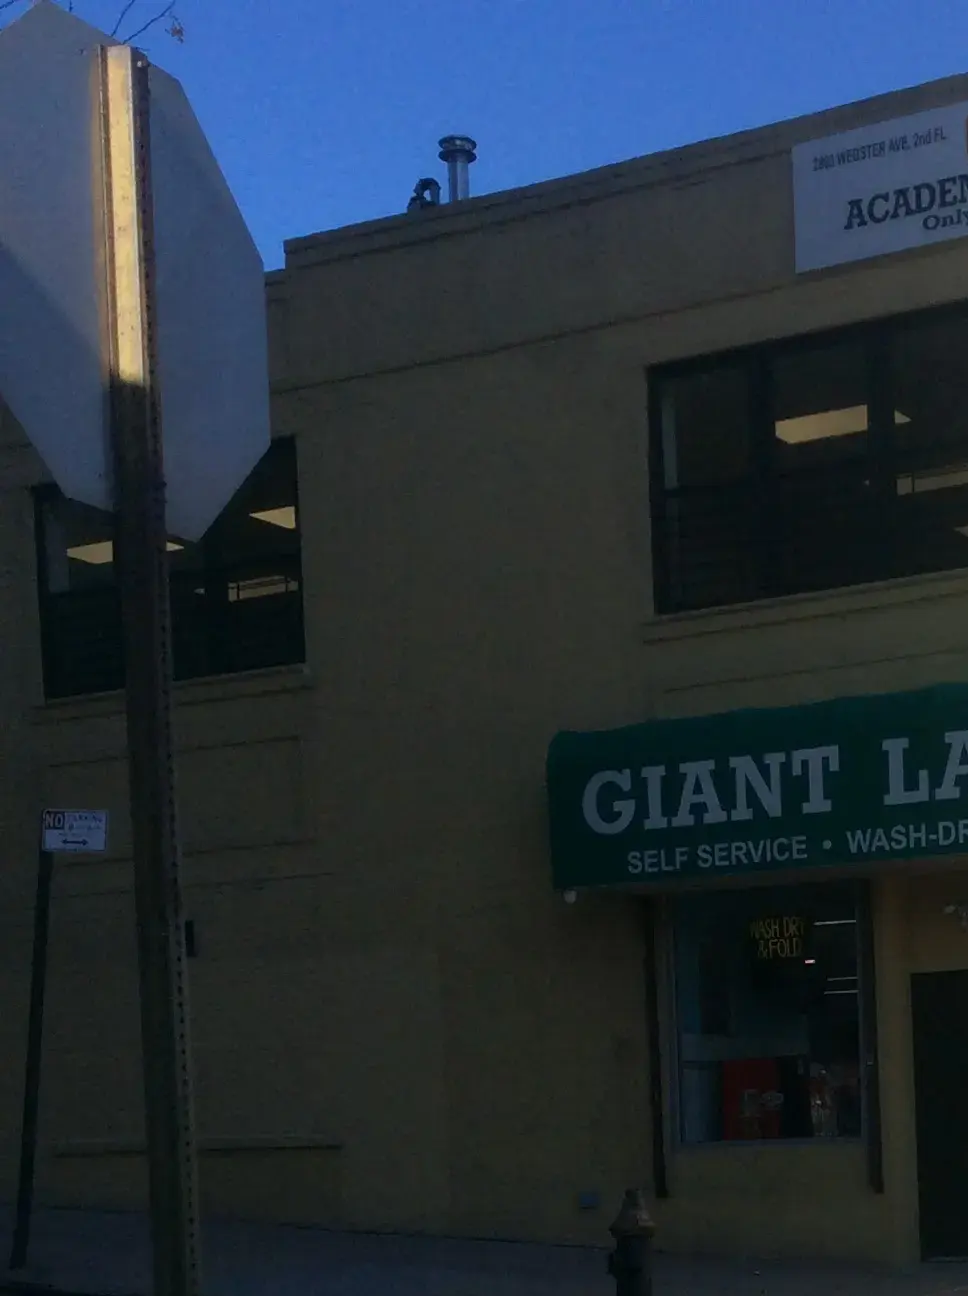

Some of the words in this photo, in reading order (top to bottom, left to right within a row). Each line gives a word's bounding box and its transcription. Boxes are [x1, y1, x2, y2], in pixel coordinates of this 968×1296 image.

[837, 141, 887, 166] WEBSTER
[912, 128, 932, 149] 2nd
[934, 126, 948, 142] FL
[582, 744, 839, 836] GIANT
[46, 813, 64, 828] NO
[627, 846, 688, 875] SELF
[696, 835, 808, 869] SERVICE
[749, 918, 780, 940] WASH
[769, 937, 803, 958] FOLD
